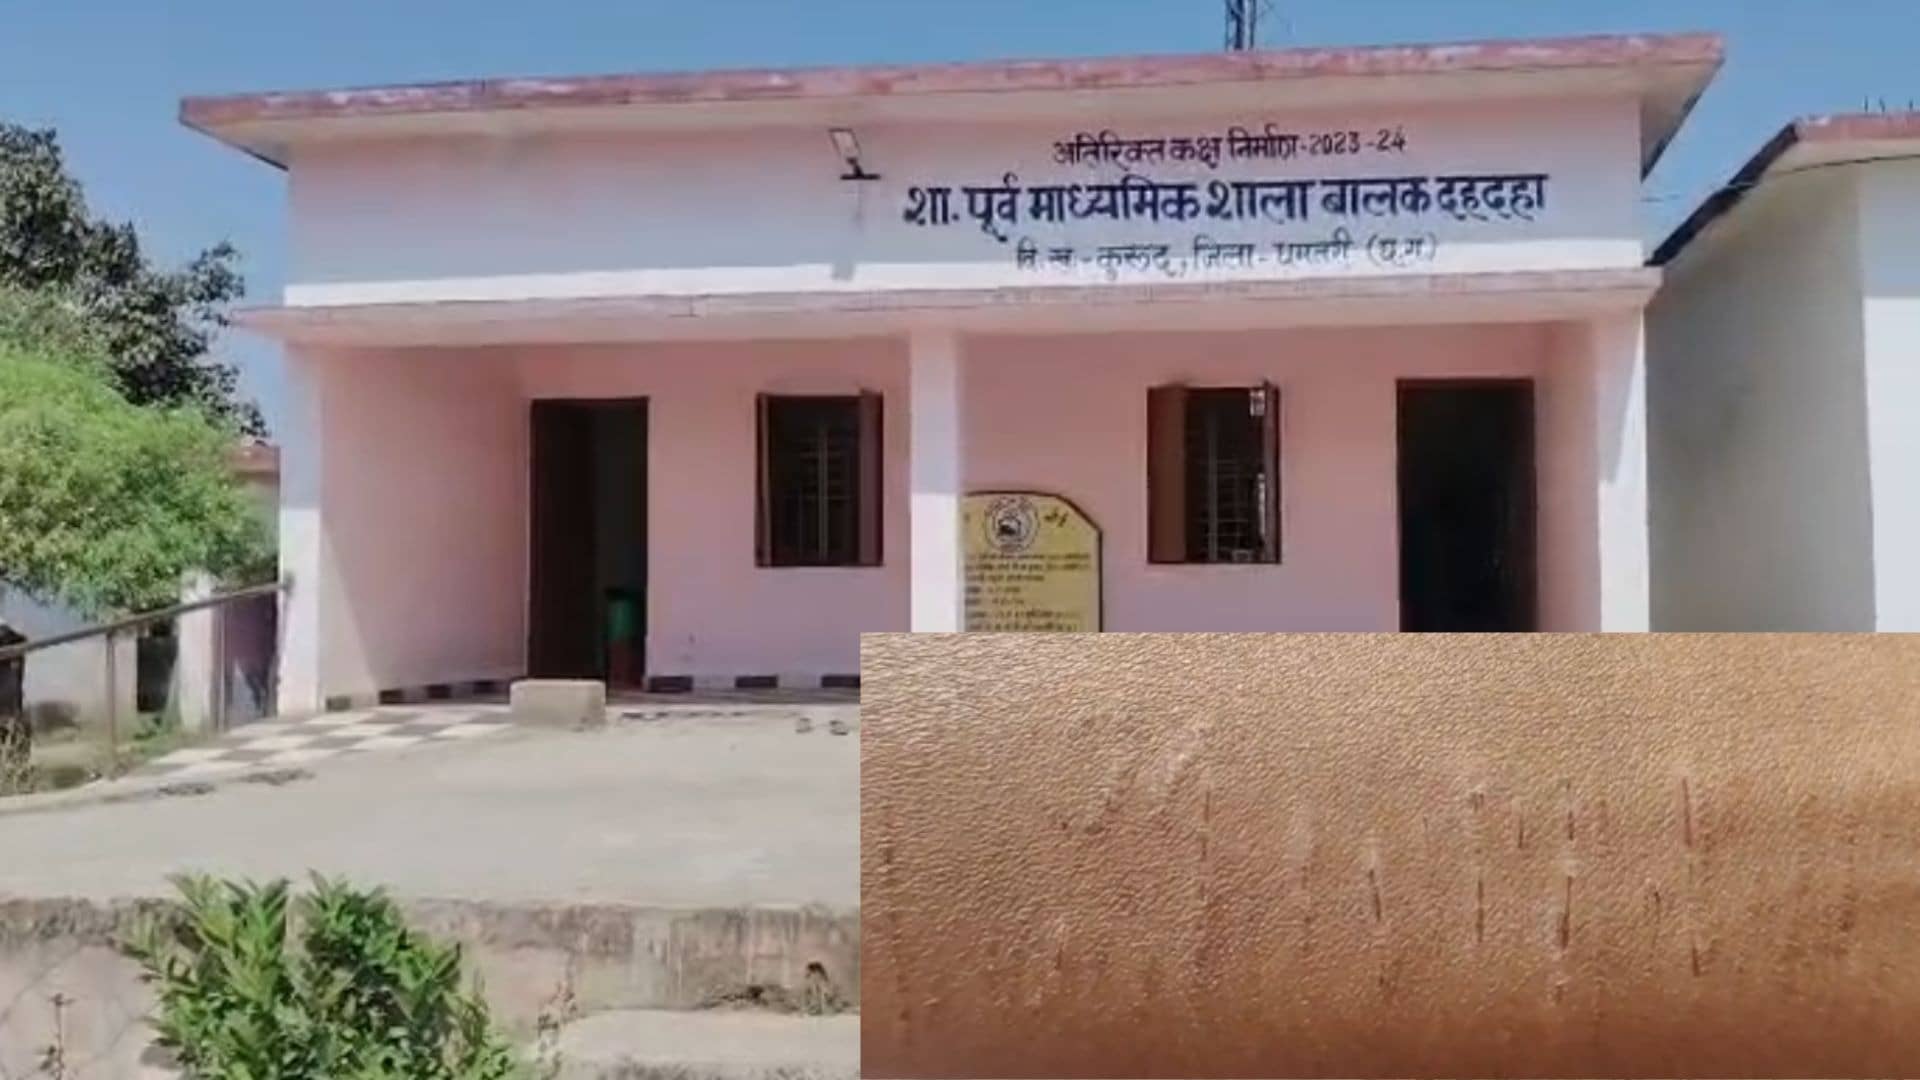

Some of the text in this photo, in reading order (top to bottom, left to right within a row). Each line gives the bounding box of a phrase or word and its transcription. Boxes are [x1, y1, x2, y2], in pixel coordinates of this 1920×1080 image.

[1053, 130, 1166, 169] अतिरिक्त
[1169, 137, 1223, 168] कक्ष
[903, 187, 959, 226] शा.
[962, 172, 1022, 242] पूर्व
[1026, 174, 1202, 222] माध्यमिक
[1206, 179, 1316, 224] शाला
[1319, 177, 1431, 216] बालक
